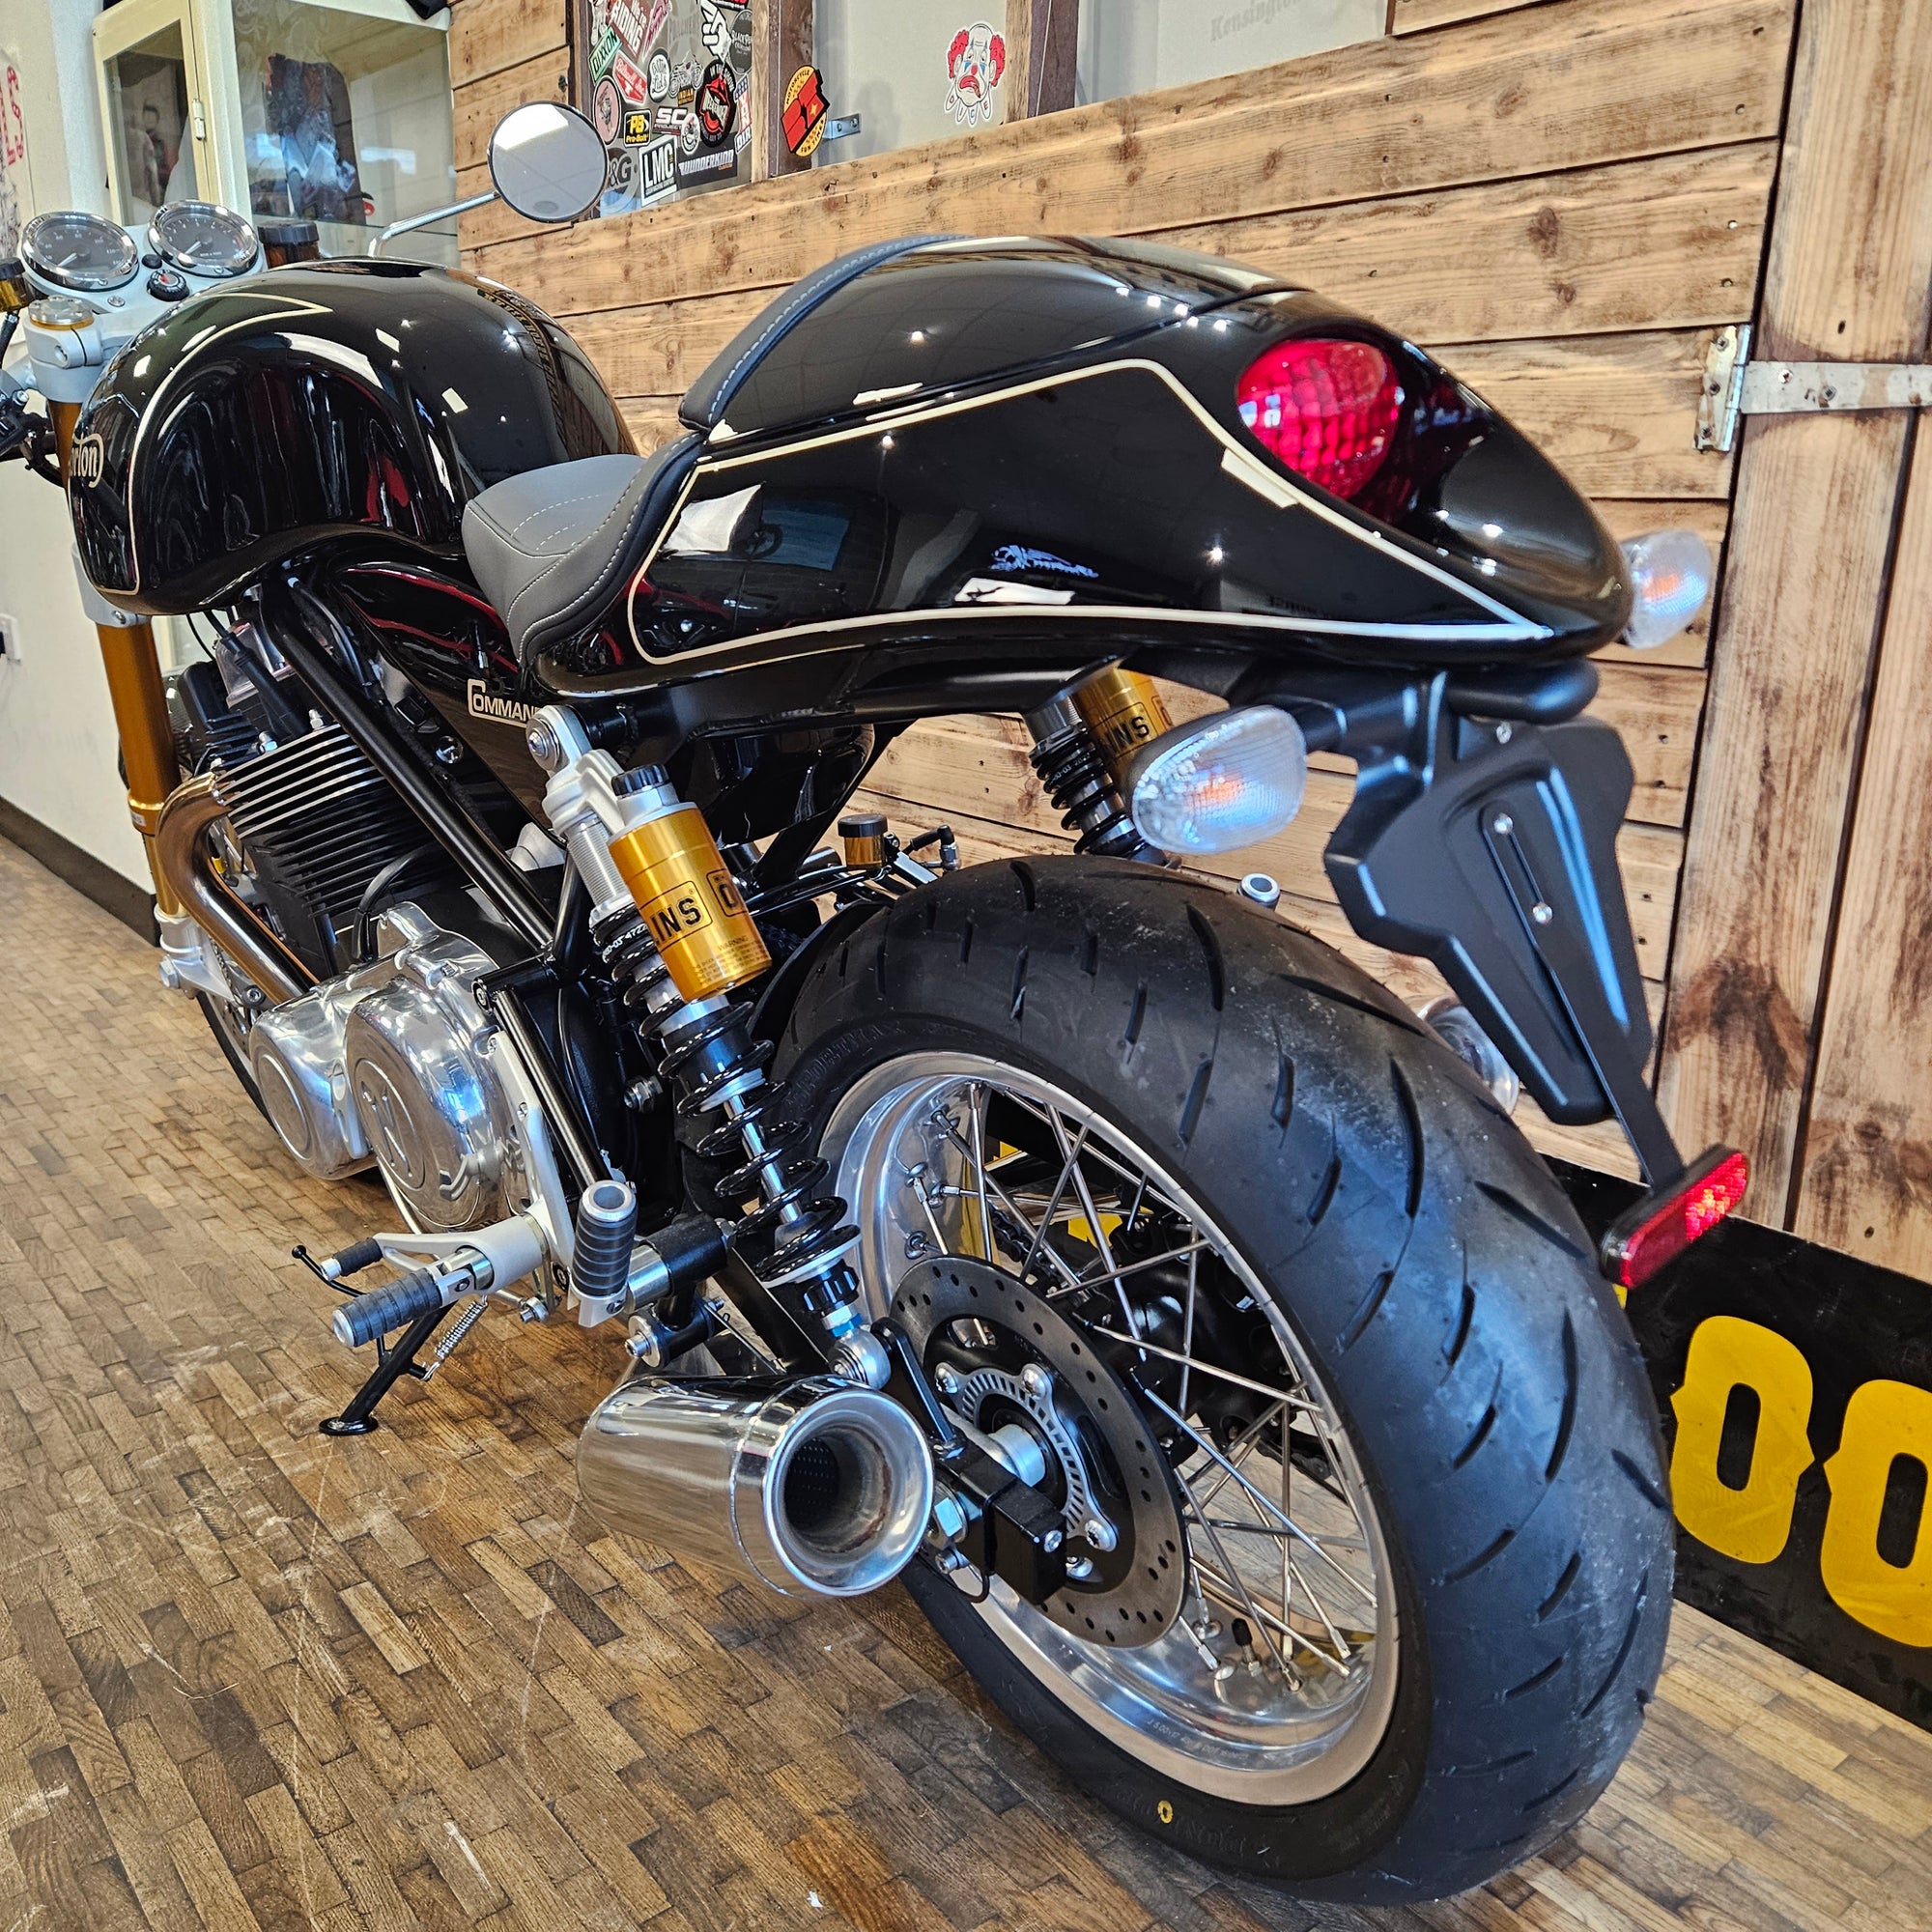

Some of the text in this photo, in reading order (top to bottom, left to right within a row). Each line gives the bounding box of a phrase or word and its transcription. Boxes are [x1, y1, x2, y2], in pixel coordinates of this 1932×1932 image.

[1209, 0, 1300, 43] Kensingto
[592, 31, 617, 73] DIXXON
[786, 70, 810, 104] MOTORCYCLE
[630, 115, 645, 133] PB
[656, 108, 687, 124] SC
[610, 156, 632, 187] &G
[643, 143, 674, 188] LMC
[468, 678, 540, 728] COMMAN
[651, 897, 701, 943] INS
